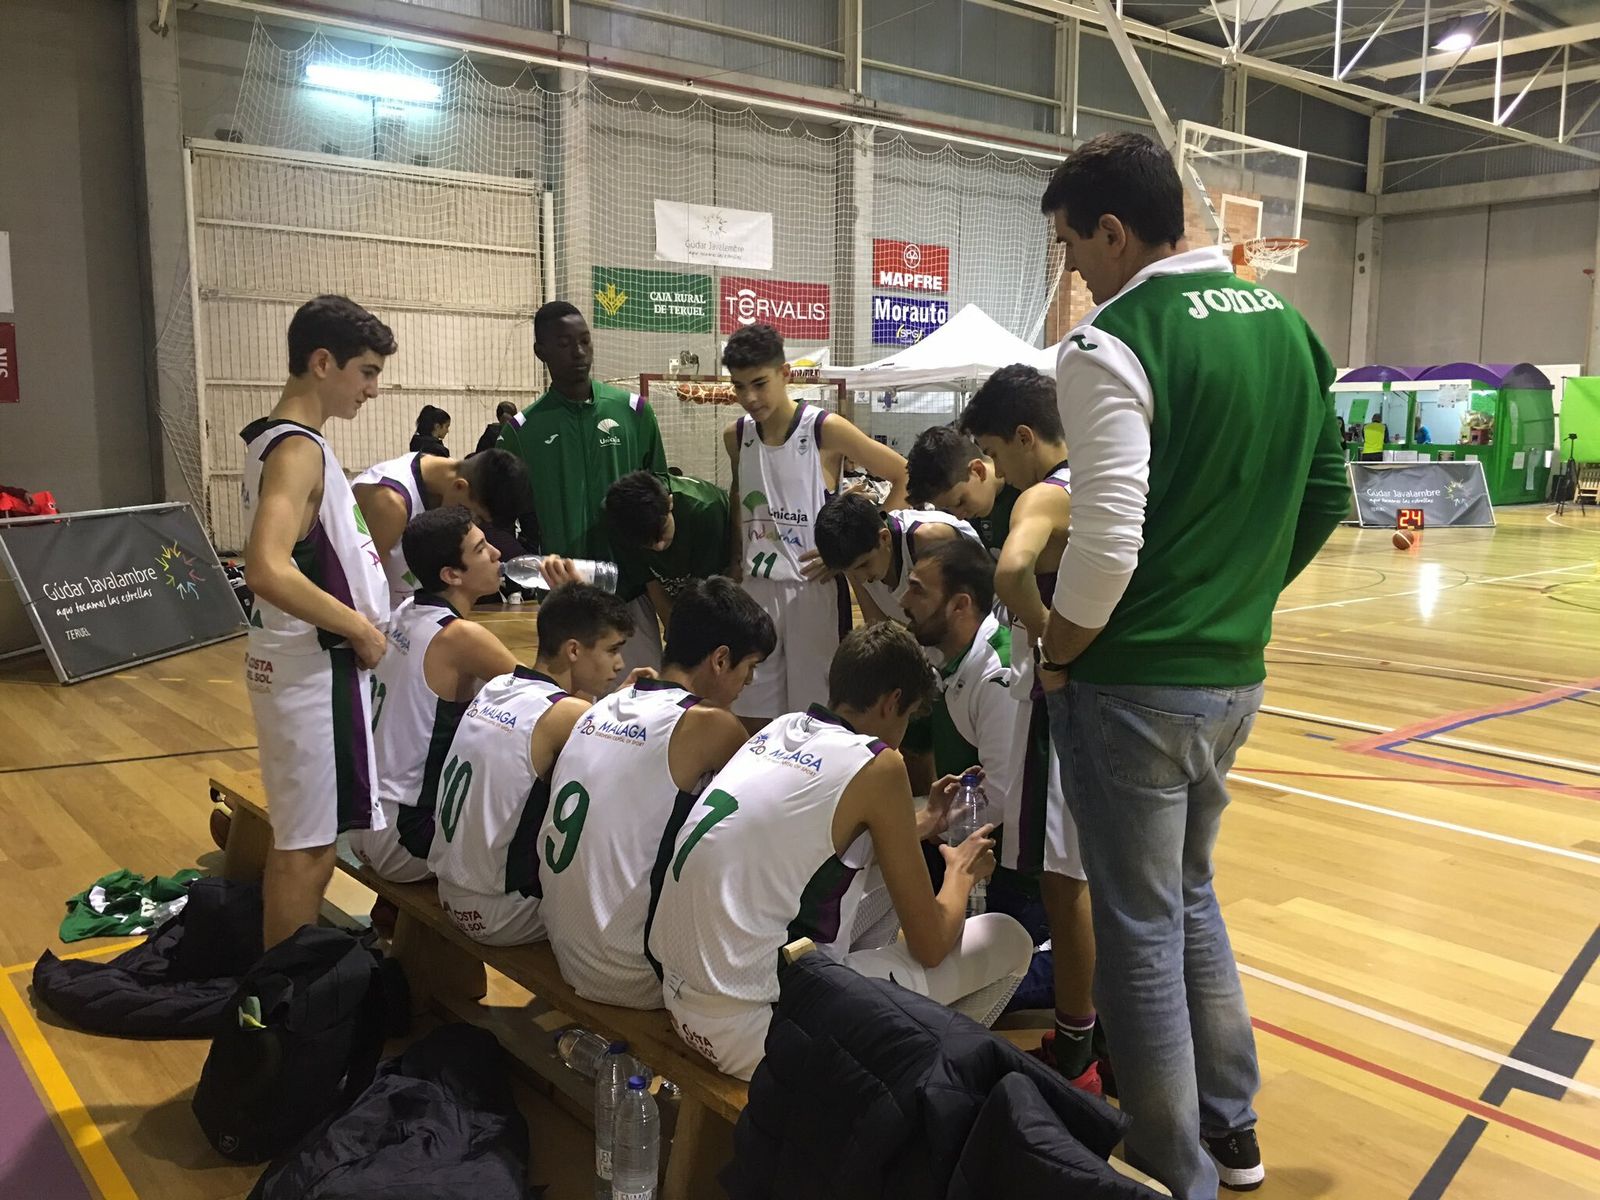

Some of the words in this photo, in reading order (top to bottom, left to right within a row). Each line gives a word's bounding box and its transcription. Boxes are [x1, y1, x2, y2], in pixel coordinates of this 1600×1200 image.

[880, 271, 943, 291] MAPFRE
[649, 291, 672, 303] CAJA
[673, 293, 707, 304] RURAL
[653, 304, 667, 314] DE
[668, 305, 705, 316] TERUEL
[875, 298, 946, 325] Morauto
[1393, 489, 1440, 498] Javalambre
[1399, 509, 1422, 527] 24
[751, 551, 778, 579] 11
[42, 580, 85, 601] Gúdar
[84, 567, 158, 594] Javalambre
[75, 600, 107, 613] tocamos
[107, 593, 120, 606] las
[121, 587, 152, 603] estrellas
[65, 627, 91, 641] TERUEL
[438, 754, 473, 843] 10
[545, 780, 591, 874] 9
[672, 788, 739, 883] 7
